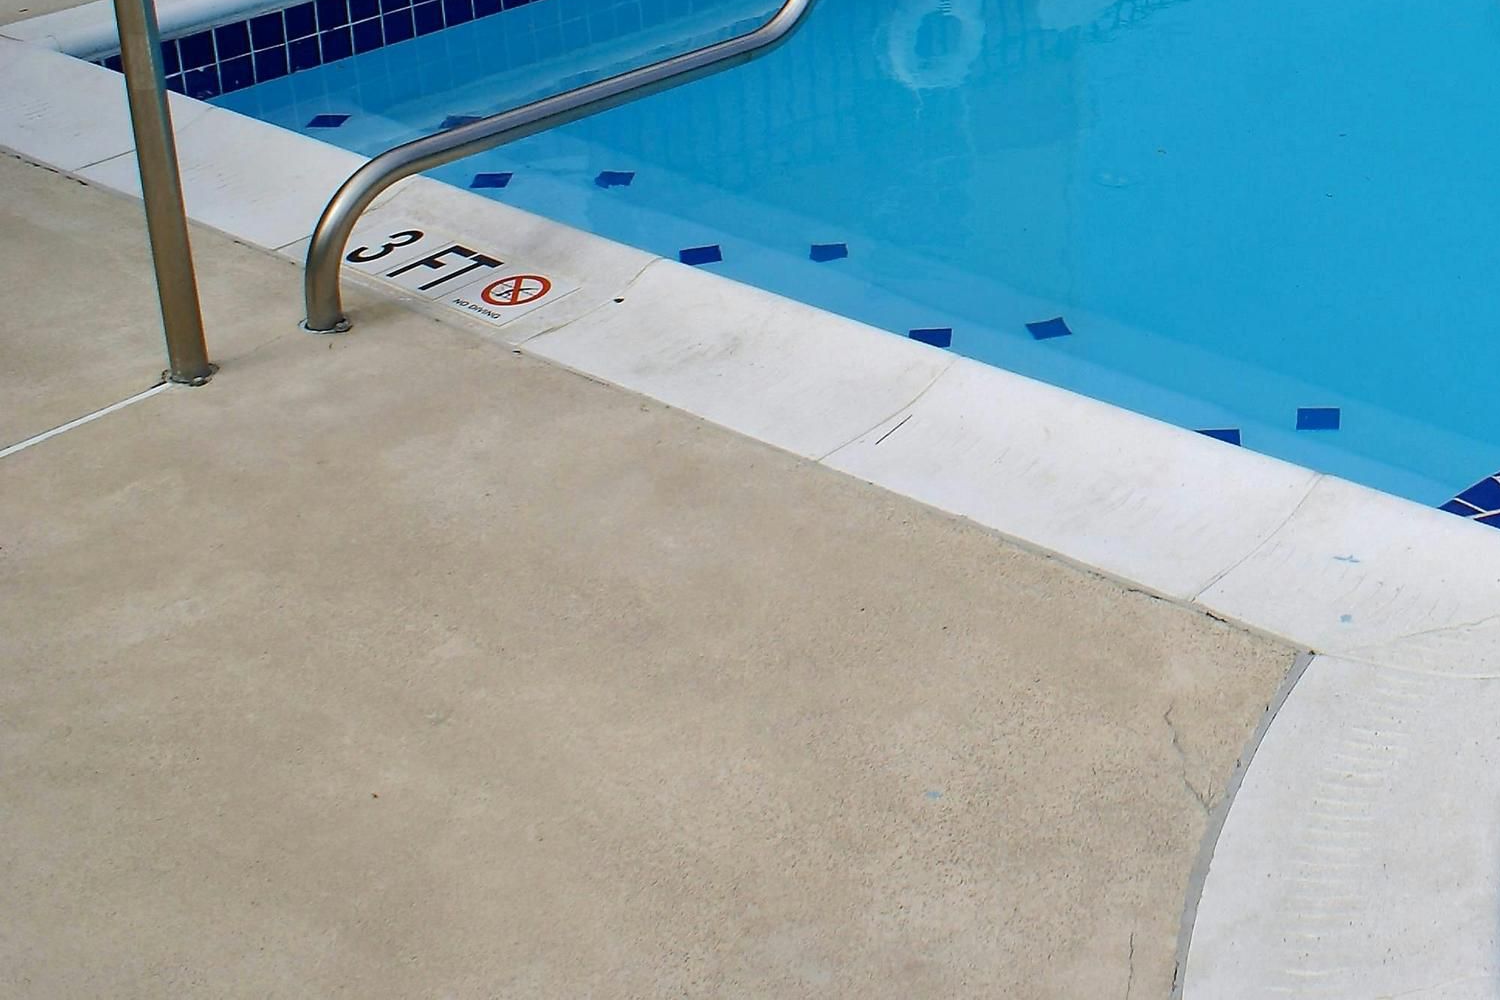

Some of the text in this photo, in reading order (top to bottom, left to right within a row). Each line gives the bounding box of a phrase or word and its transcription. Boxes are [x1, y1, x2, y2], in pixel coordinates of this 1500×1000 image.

[346, 229, 504, 291] 3 FT
[452, 298, 501, 319] NO DIVING
